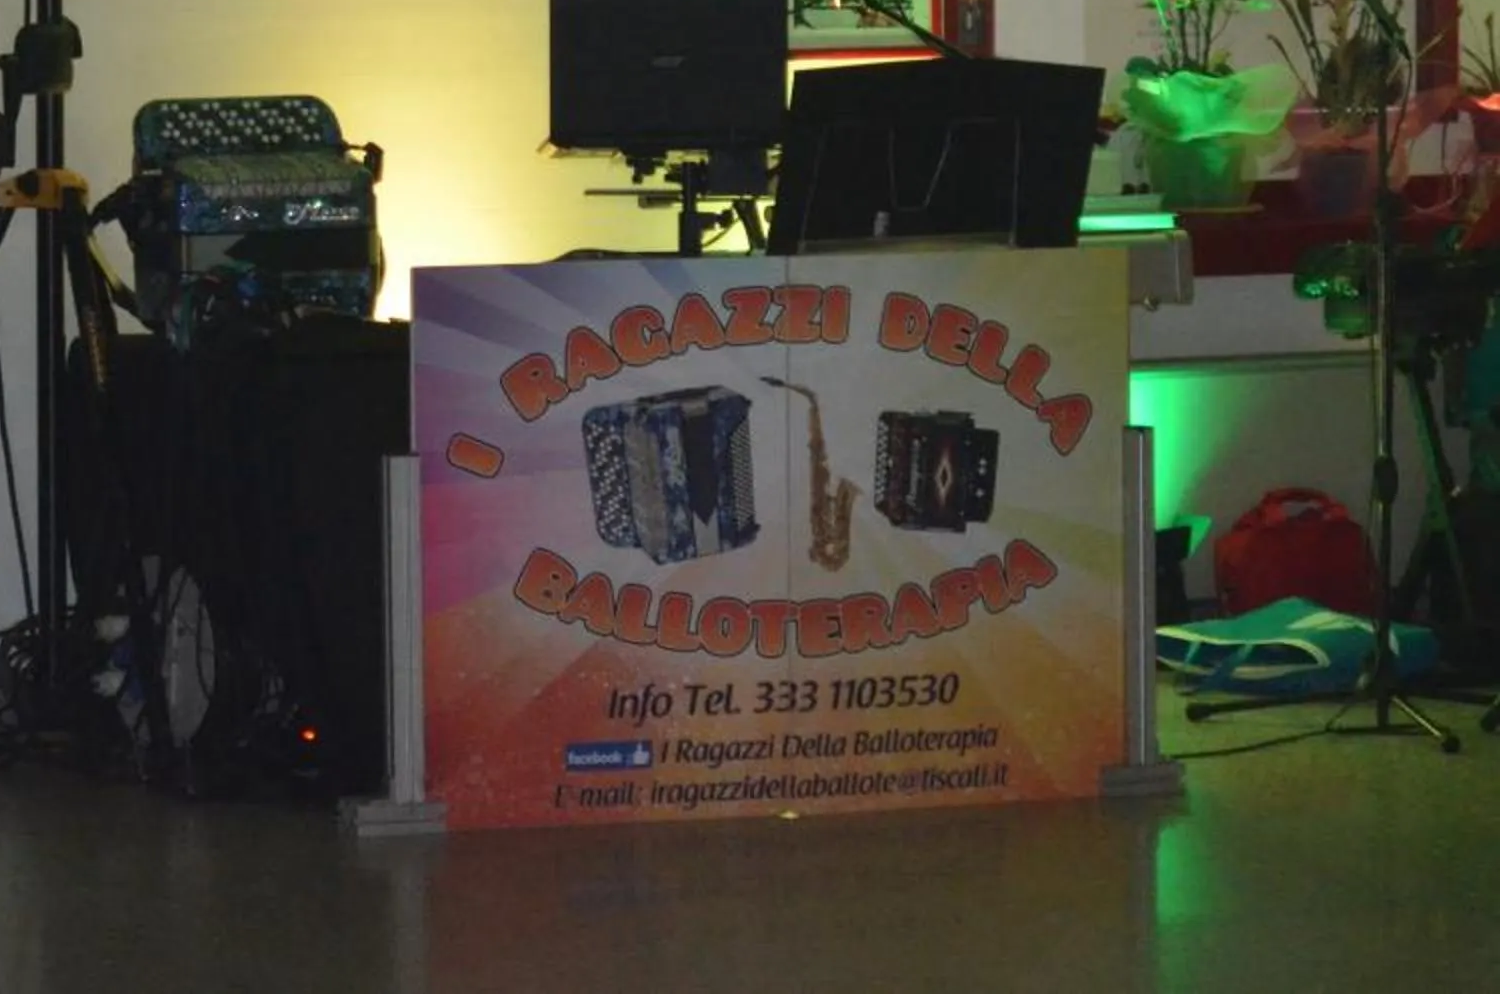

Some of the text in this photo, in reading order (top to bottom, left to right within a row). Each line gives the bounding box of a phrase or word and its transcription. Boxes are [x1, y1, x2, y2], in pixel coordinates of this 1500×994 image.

[446, 285, 1094, 480] I RAGAZZI DELLA
[513, 538, 1059, 659] BALLOTERAPIA
[608, 672, 960, 728] Info Tel. 333 1103530
[567, 749, 623, 767] facebook
[660, 724, 998, 770] I Ragazzi Della Balloterapia
